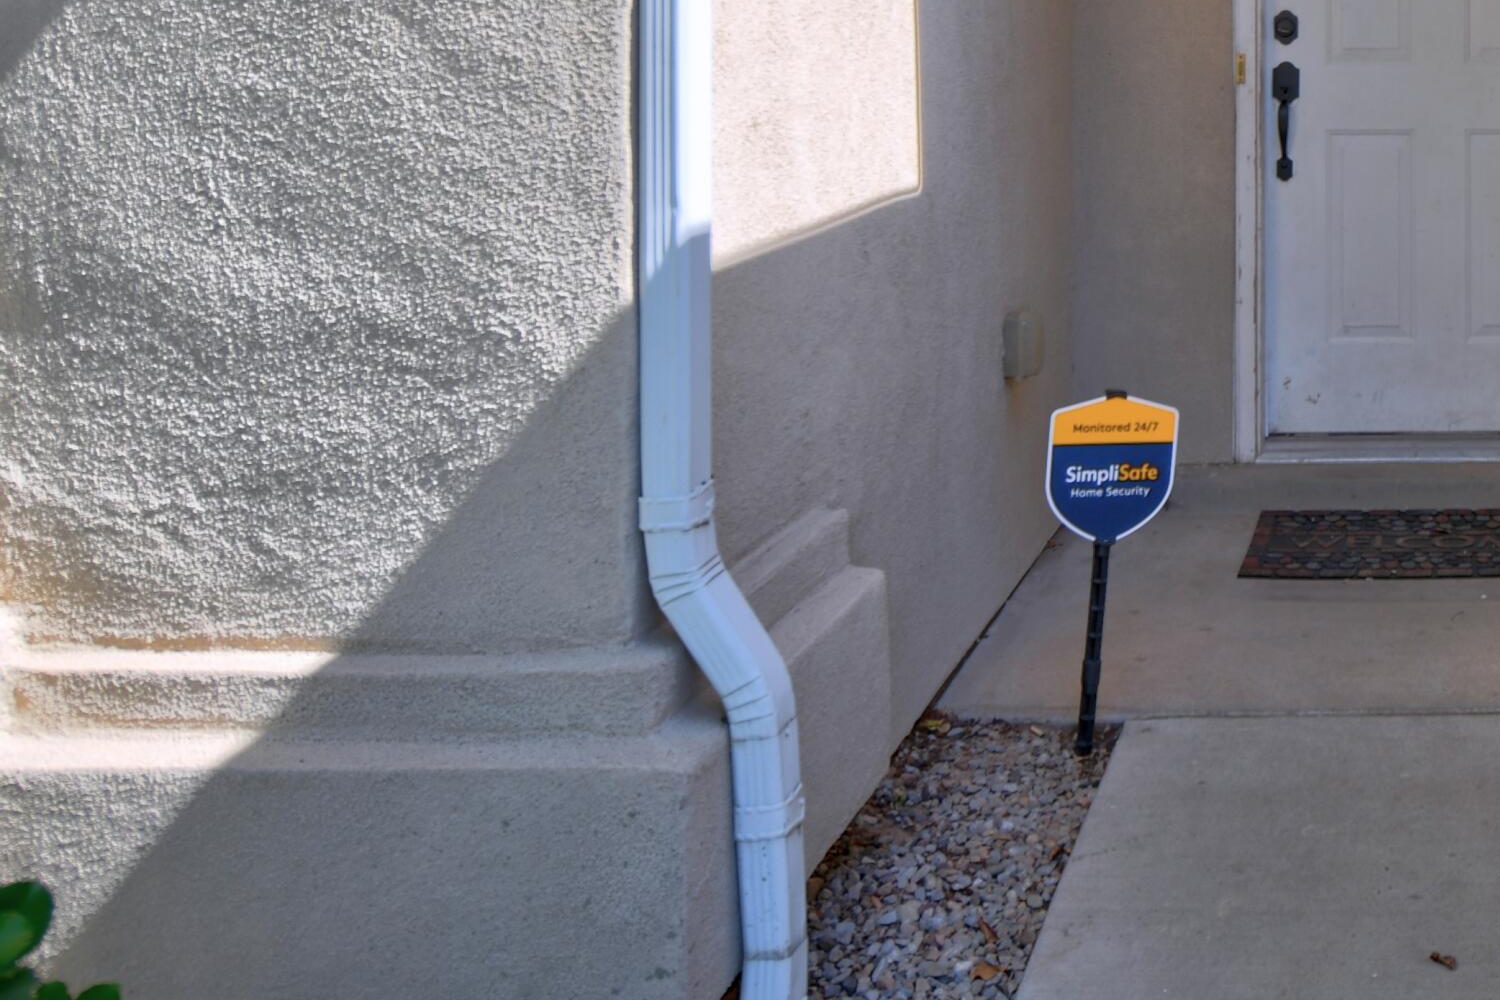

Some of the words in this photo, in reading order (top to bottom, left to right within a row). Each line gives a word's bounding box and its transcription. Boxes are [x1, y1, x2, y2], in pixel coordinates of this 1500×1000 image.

[1073, 423, 1130, 433] Monitored
[1133, 422, 1159, 432] 24/7
[1065, 463, 1158, 485] SimpliSafe
[1071, 487, 1103, 498] Home
[1106, 485, 1150, 497] Security
